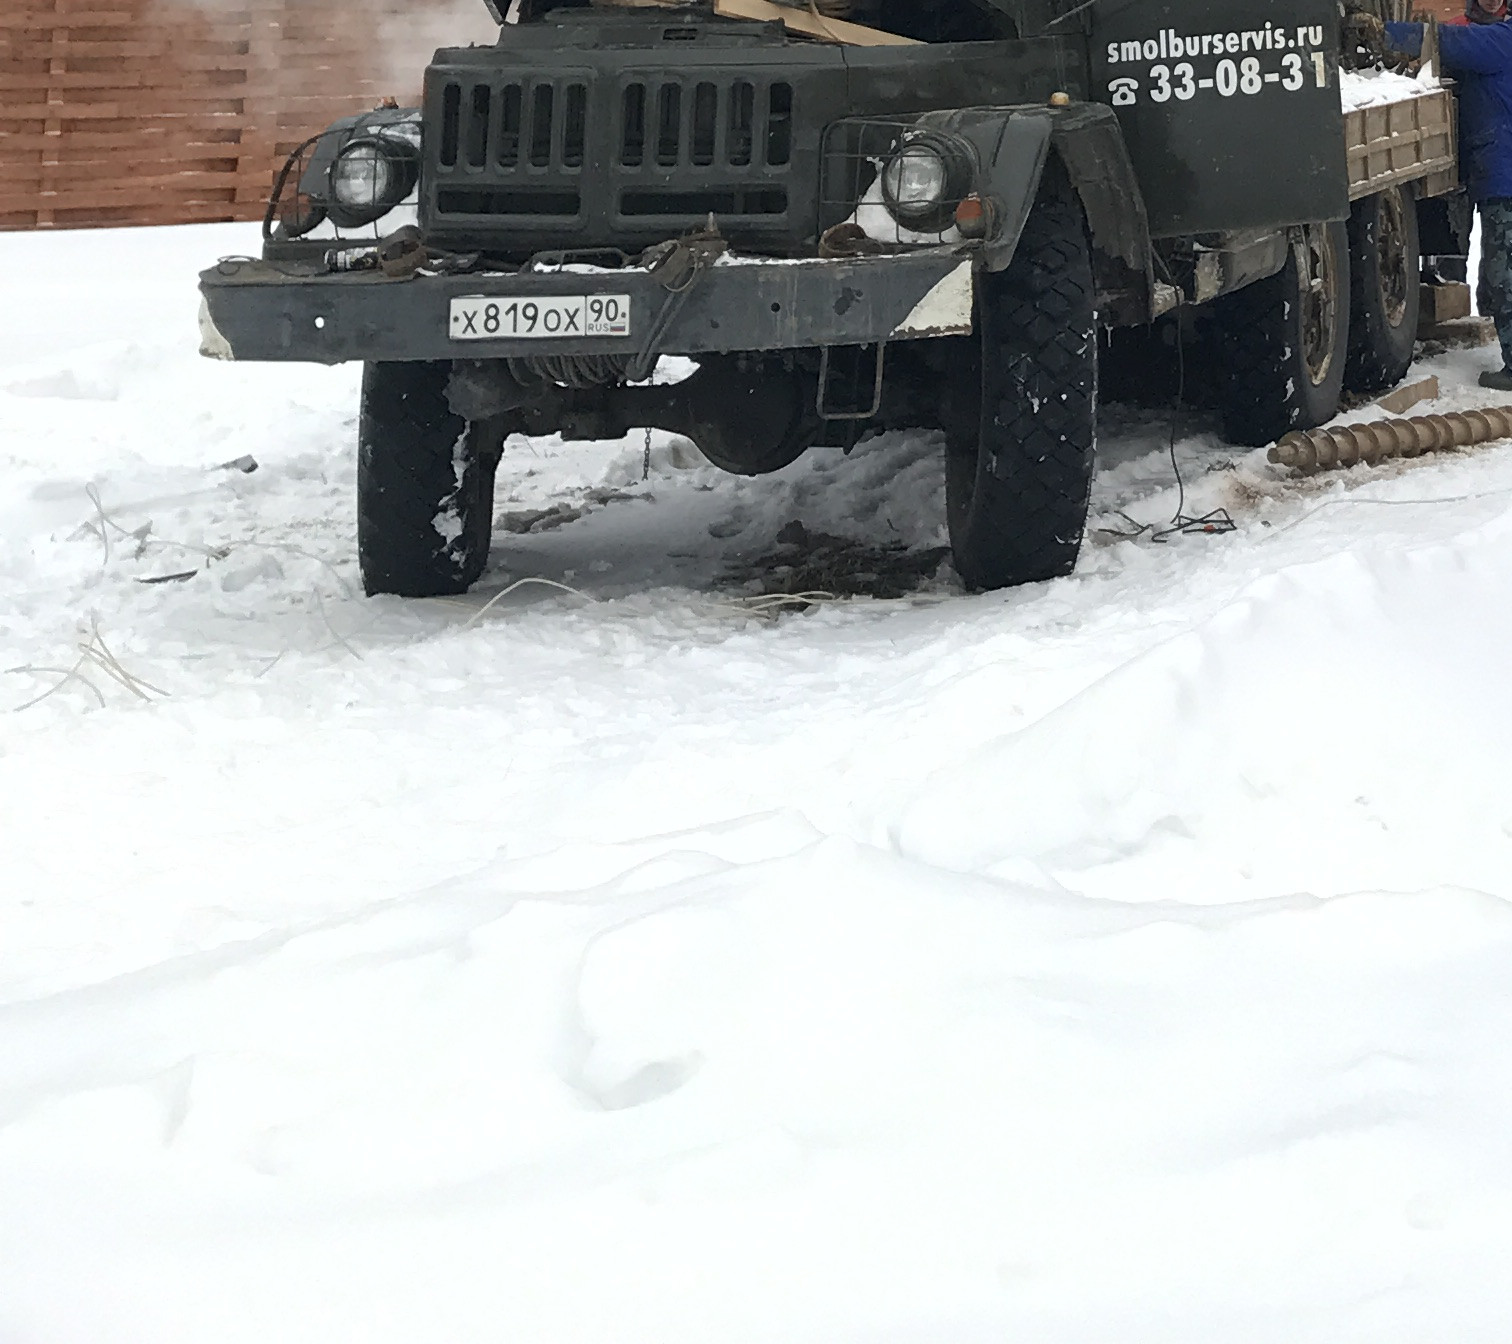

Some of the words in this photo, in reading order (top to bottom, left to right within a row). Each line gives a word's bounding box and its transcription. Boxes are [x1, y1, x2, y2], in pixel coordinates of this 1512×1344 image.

[1107, 21, 1323, 63] smolburservis.ru
[1149, 51, 1326, 103] 33-08-31
[590, 298, 619, 322] 90
[587, 323, 609, 332] RUS
